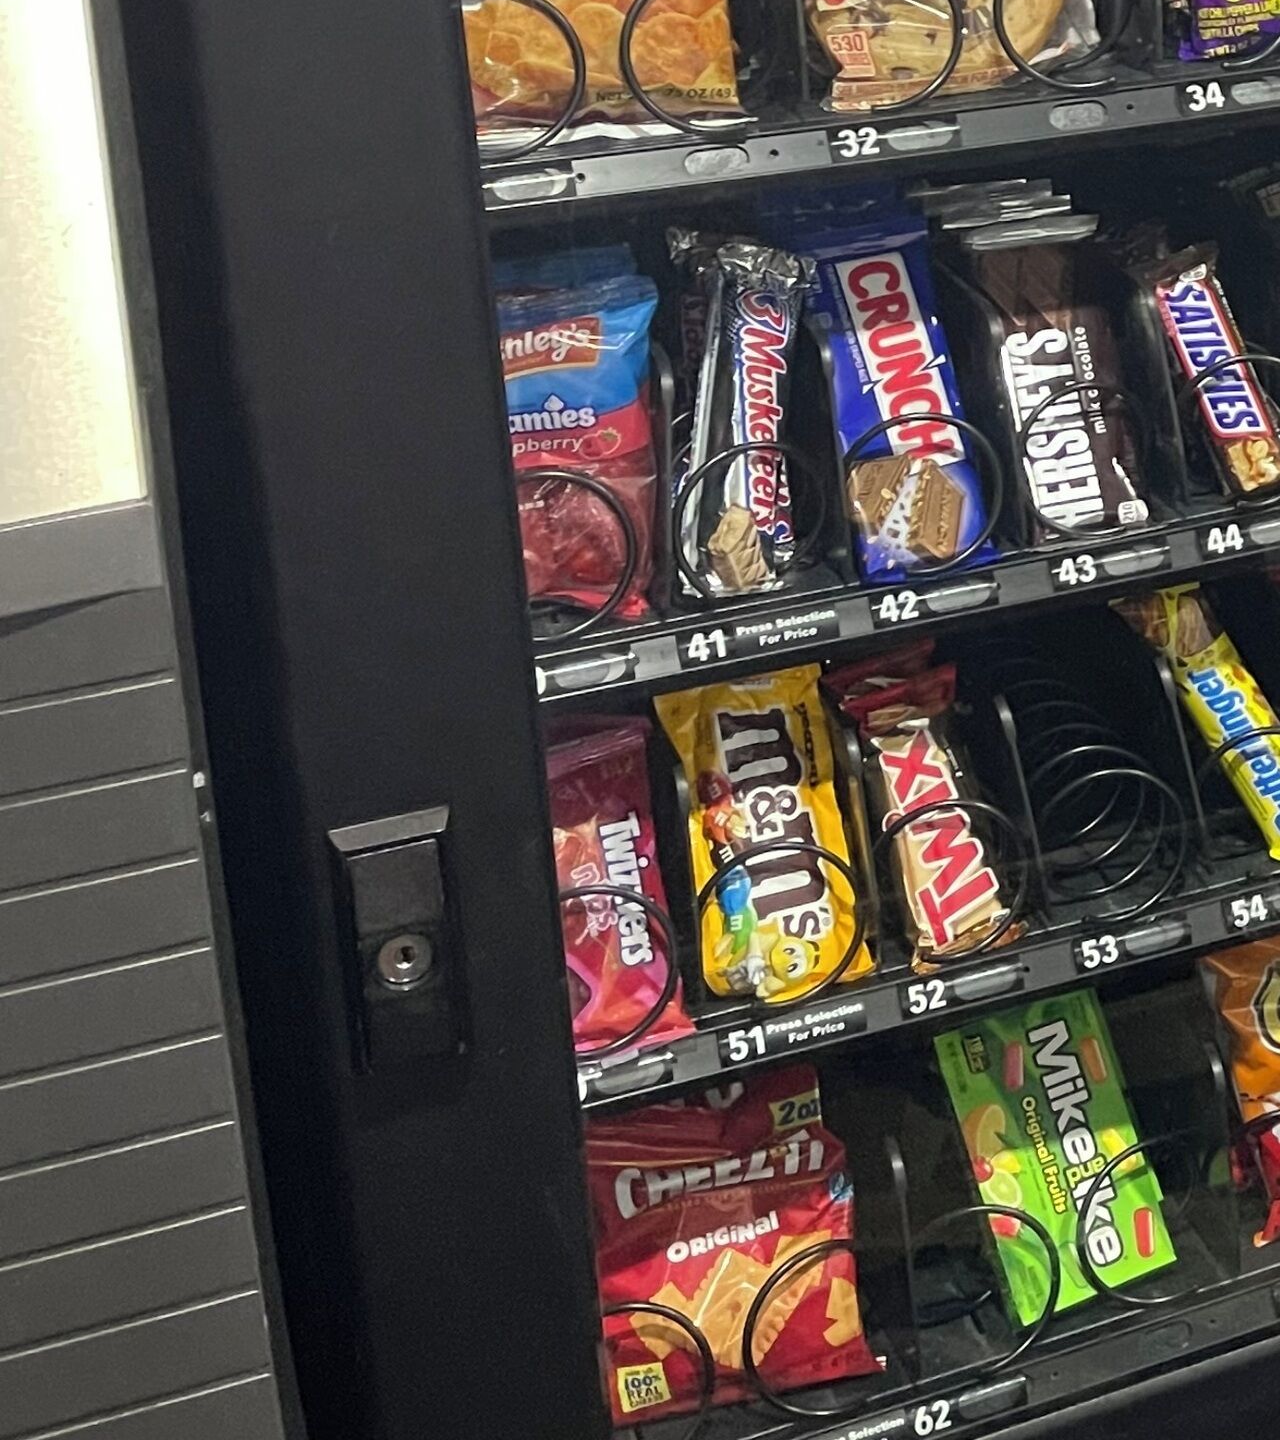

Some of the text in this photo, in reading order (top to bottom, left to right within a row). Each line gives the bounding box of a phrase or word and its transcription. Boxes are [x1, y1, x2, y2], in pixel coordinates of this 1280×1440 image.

[831, 35, 864, 52] 530
[1186, 82, 1225, 110] 34
[837, 127, 880, 158] 32
[847, 261, 957, 460] CRUNCH
[1207, 523, 1243, 553] 44
[1058, 555, 1098, 585] 43
[877, 591, 920, 621] 42
[687, 628, 729, 661] 41
[759, 627, 818, 647] For Price
[1232, 894, 1267, 927] 54
[1081, 935, 1119, 969] 53
[908, 979, 948, 1015] 52
[728, 1024, 768, 1061] 51
[788, 1023, 846, 1044] For Price
[1020, 1096, 1067, 1215] Original Fruits
[1028, 1020, 1125, 1266] Mike and Ike
[914, 1399, 952, 1437] 62
